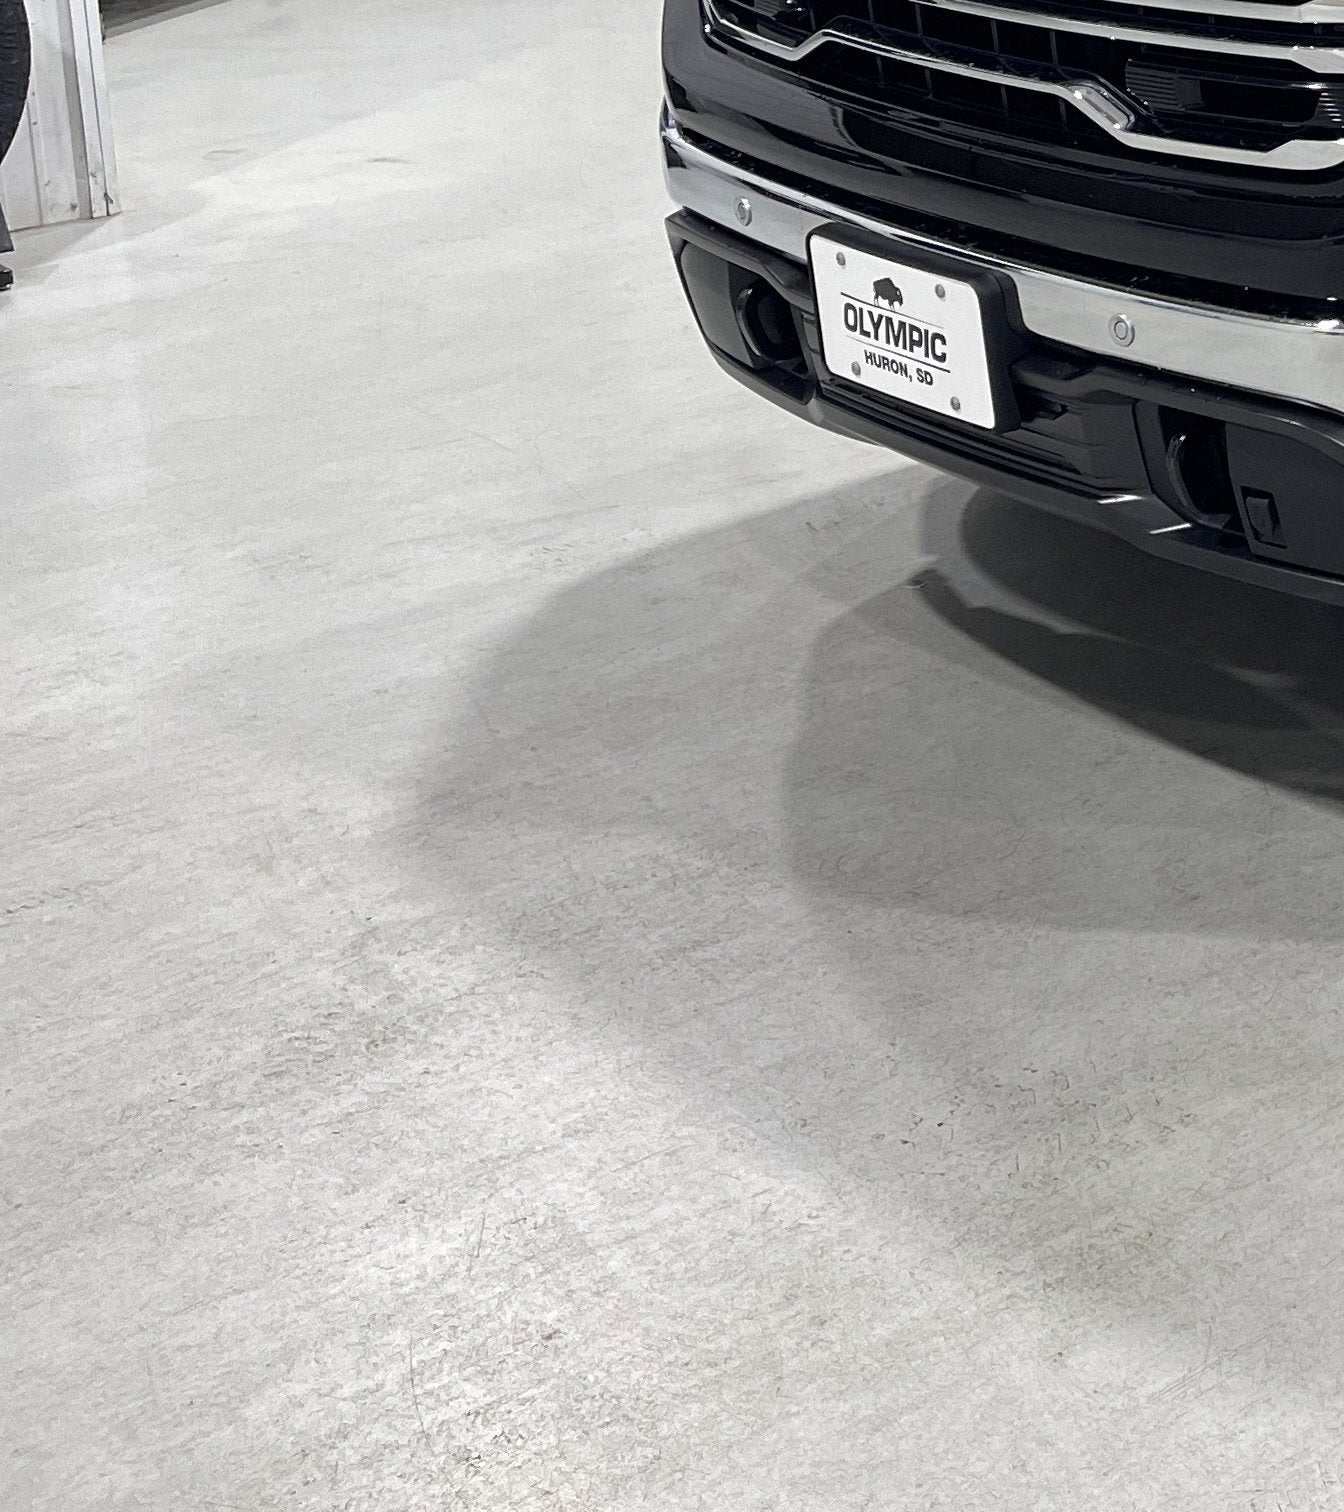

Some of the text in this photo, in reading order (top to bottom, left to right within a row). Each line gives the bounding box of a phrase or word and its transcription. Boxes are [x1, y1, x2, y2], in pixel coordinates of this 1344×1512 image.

[843, 301, 948, 364] OLYMPIC
[863, 349, 934, 386] HURON, SD
